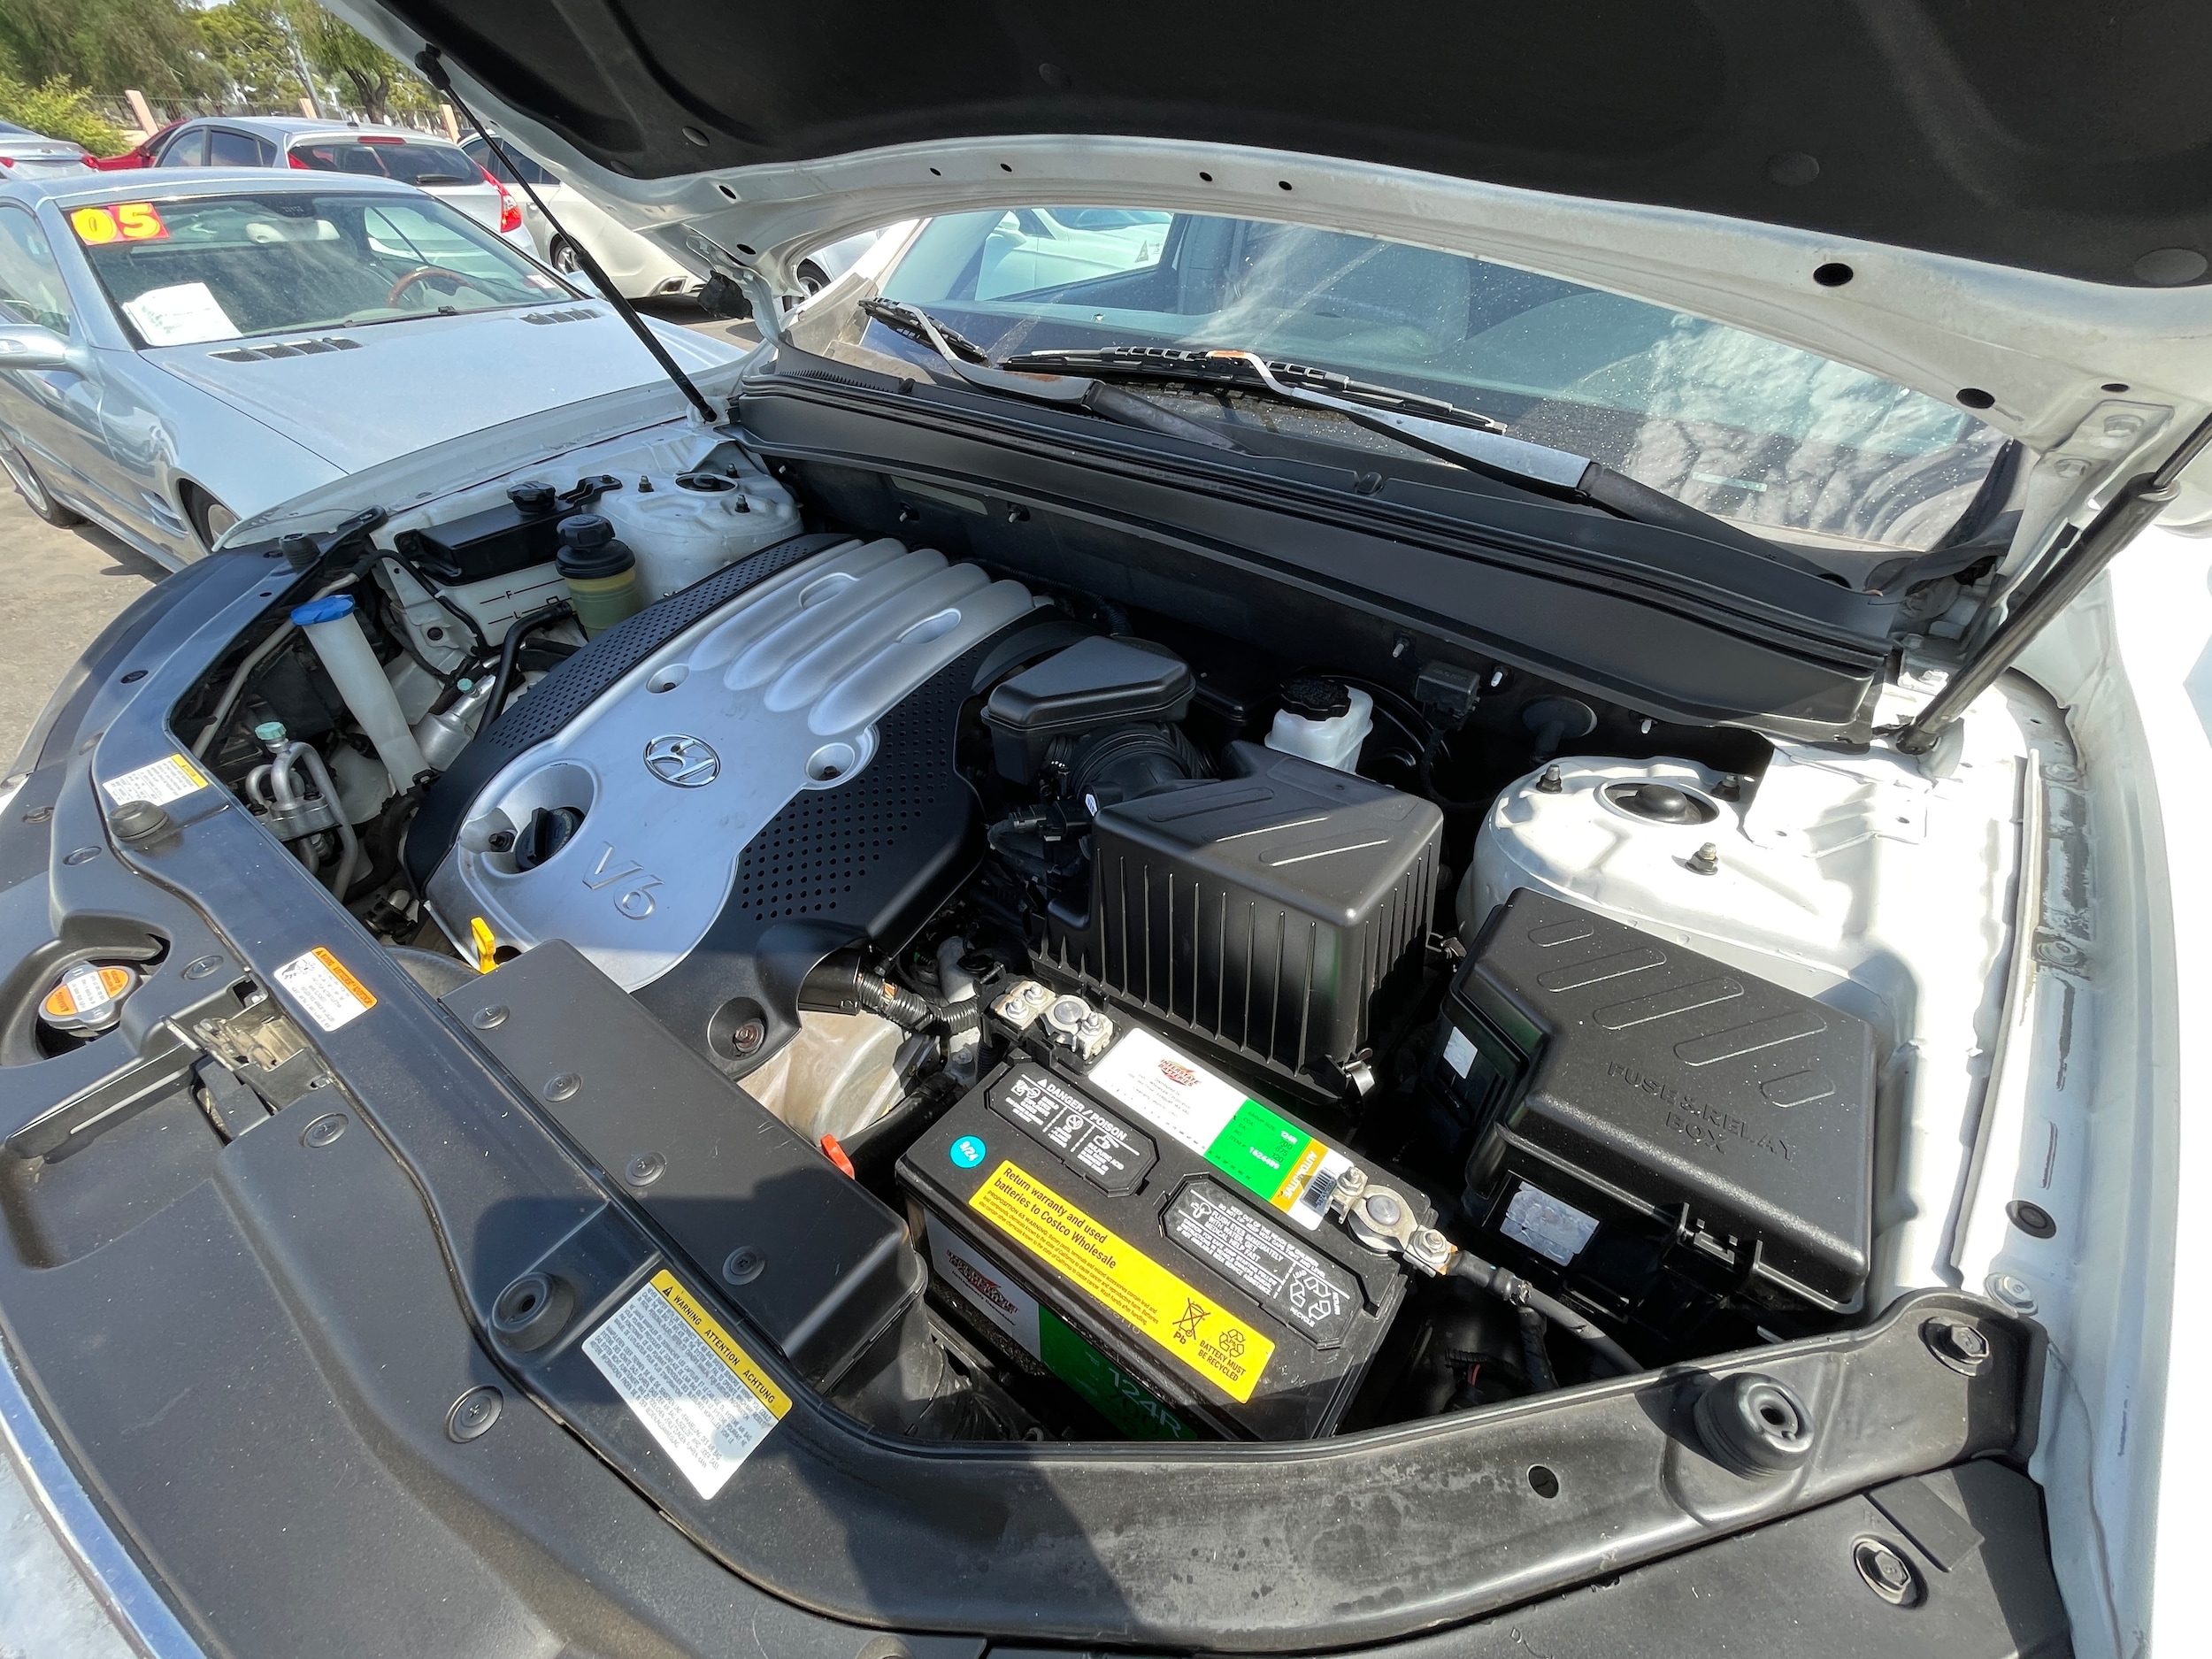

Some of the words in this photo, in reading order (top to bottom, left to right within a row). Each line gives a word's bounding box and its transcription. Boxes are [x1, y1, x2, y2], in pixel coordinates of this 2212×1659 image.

[73, 204, 161, 242] 05
[505, 590, 513, 599] F
[513, 611, 521, 619] L
[582, 841, 664, 921] V6
[1157, 1063, 1193, 1087] BATTERIES
[1160, 1058, 1199, 1085] INTERSTATE
[1045, 1083, 1087, 1112] DANGER
[1088, 1112, 1128, 1141] POISON
[1274, 1145, 1289, 1156] 875
[1278, 1138, 1294, 1150] 700
[1279, 1129, 1298, 1145] 124R
[1666, 1111, 1727, 1155] BOX
[960, 1141, 979, 1162] 9/24
[1086, 1141, 1113, 1162] SULFURIC
[1110, 1158, 1125, 1171] ACID
[1270, 1151, 1284, 1164] 120
[1280, 1149, 1319, 1200] AUTOMOTIVE
[993, 1177, 1033, 1208] batteries
[1029, 1203, 1041, 1215] to
[1039, 1210, 1072, 1236] Costco
[1069, 1231, 1118, 1269] Wholesale
[1002, 1167, 1033, 1191] Return
[1028, 1187, 1068, 1218] warranty
[1065, 1210, 1086, 1228] and
[1083, 1223, 1107, 1243] used
[1241, 1214, 1253, 1223] OUT
[987, 1189, 1018, 1214] PROPOSITION
[1024, 1217, 1049, 1236] WARNING:
[1047, 1233, 1061, 1246] Battery
[1070, 1250, 1087, 1263] terminals
[1093, 1266, 1107, 1278] related
[1105, 1275, 1127, 1293] accessories
[1126, 1290, 1141, 1302] contain
[1140, 1299, 1149, 1309] lead
[1148, 1305, 1157, 1314] and
[1203, 1221, 1230, 1240] MEDICAL
[1228, 1238, 1245, 1252] HELP
[1243, 1248, 1261, 1263] FAST
[1207, 1216, 1224, 1229] WITH
[1243, 1240, 1257, 1252] GET
[1210, 1210, 1231, 1226] FLUSH
[1229, 1222, 1246, 1236] EYES
[1244, 1233, 1285, 1262] IMMEDIATELY
[1005, 1219, 1023, 1233] chemicals
[1021, 1232, 1033, 1241] known
[1042, 1247, 1052, 1256] state
[1055, 1256, 1072, 1270] California
[1075, 1271, 1087, 1281] cause
[1099, 1287, 1110, 1298] Wash
[1110, 1295, 1122, 1306] hands
[1121, 1303, 1131, 1312] after
[1008, 1213, 1025, 1227] chemicals
[1025, 1225, 1036, 1235] known
[1057, 1248, 1075, 1263] California
[1079, 1264, 1089, 1274] cause
[1089, 1271, 1102, 1283] cancer
[1108, 1286, 1131, 1304] reproductive
[1141, 1309, 1159, 1324] Batteries
[1288, 1306, 1316, 1327] RECYCLE
[672, 1294, 702, 1325] WARNING
[703, 1328, 740, 1365] ATTENTION
[742, 1368, 775, 1403] ACHTUNG
[1172, 1330, 1187, 1345] Pb
[1197, 1348, 1208, 1359] BE
[1206, 1355, 1239, 1382] RECYCLED
[1199, 1340, 1227, 1363] BATTERY
[1225, 1358, 1246, 1376] MUST
[1108, 1368, 1182, 1439] 124R
